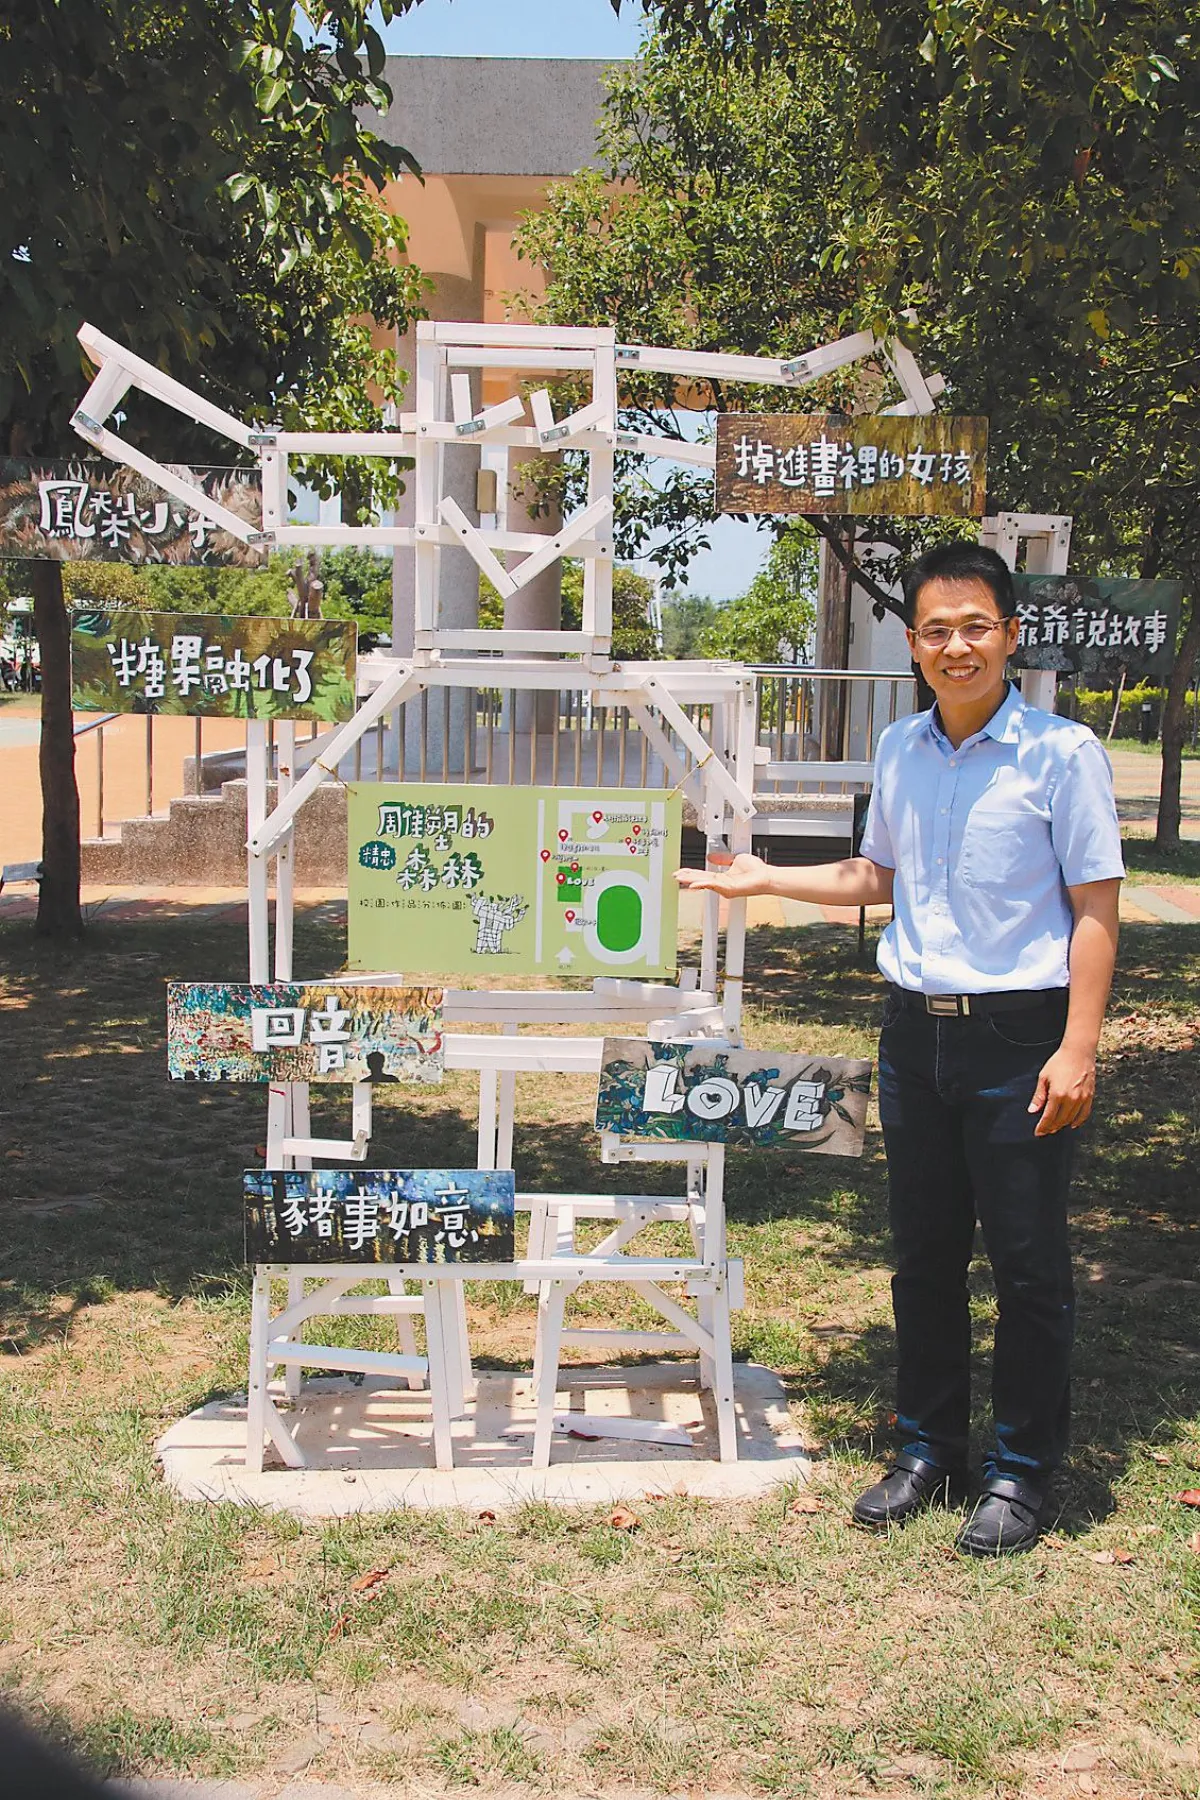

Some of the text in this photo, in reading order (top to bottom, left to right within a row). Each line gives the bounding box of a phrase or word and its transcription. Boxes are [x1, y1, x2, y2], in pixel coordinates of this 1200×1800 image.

[733, 434, 972, 497] 掉進畫裡的女孩
[1014, 603, 1168, 653] 爺爺說故事
[106, 635, 315, 704] 糖果融化了
[396, 842, 485, 892] 森林
[251, 995, 352, 1074] 回音
[642, 1063, 827, 1132] LOVE
[280, 1181, 478, 1250] 豬事如意
